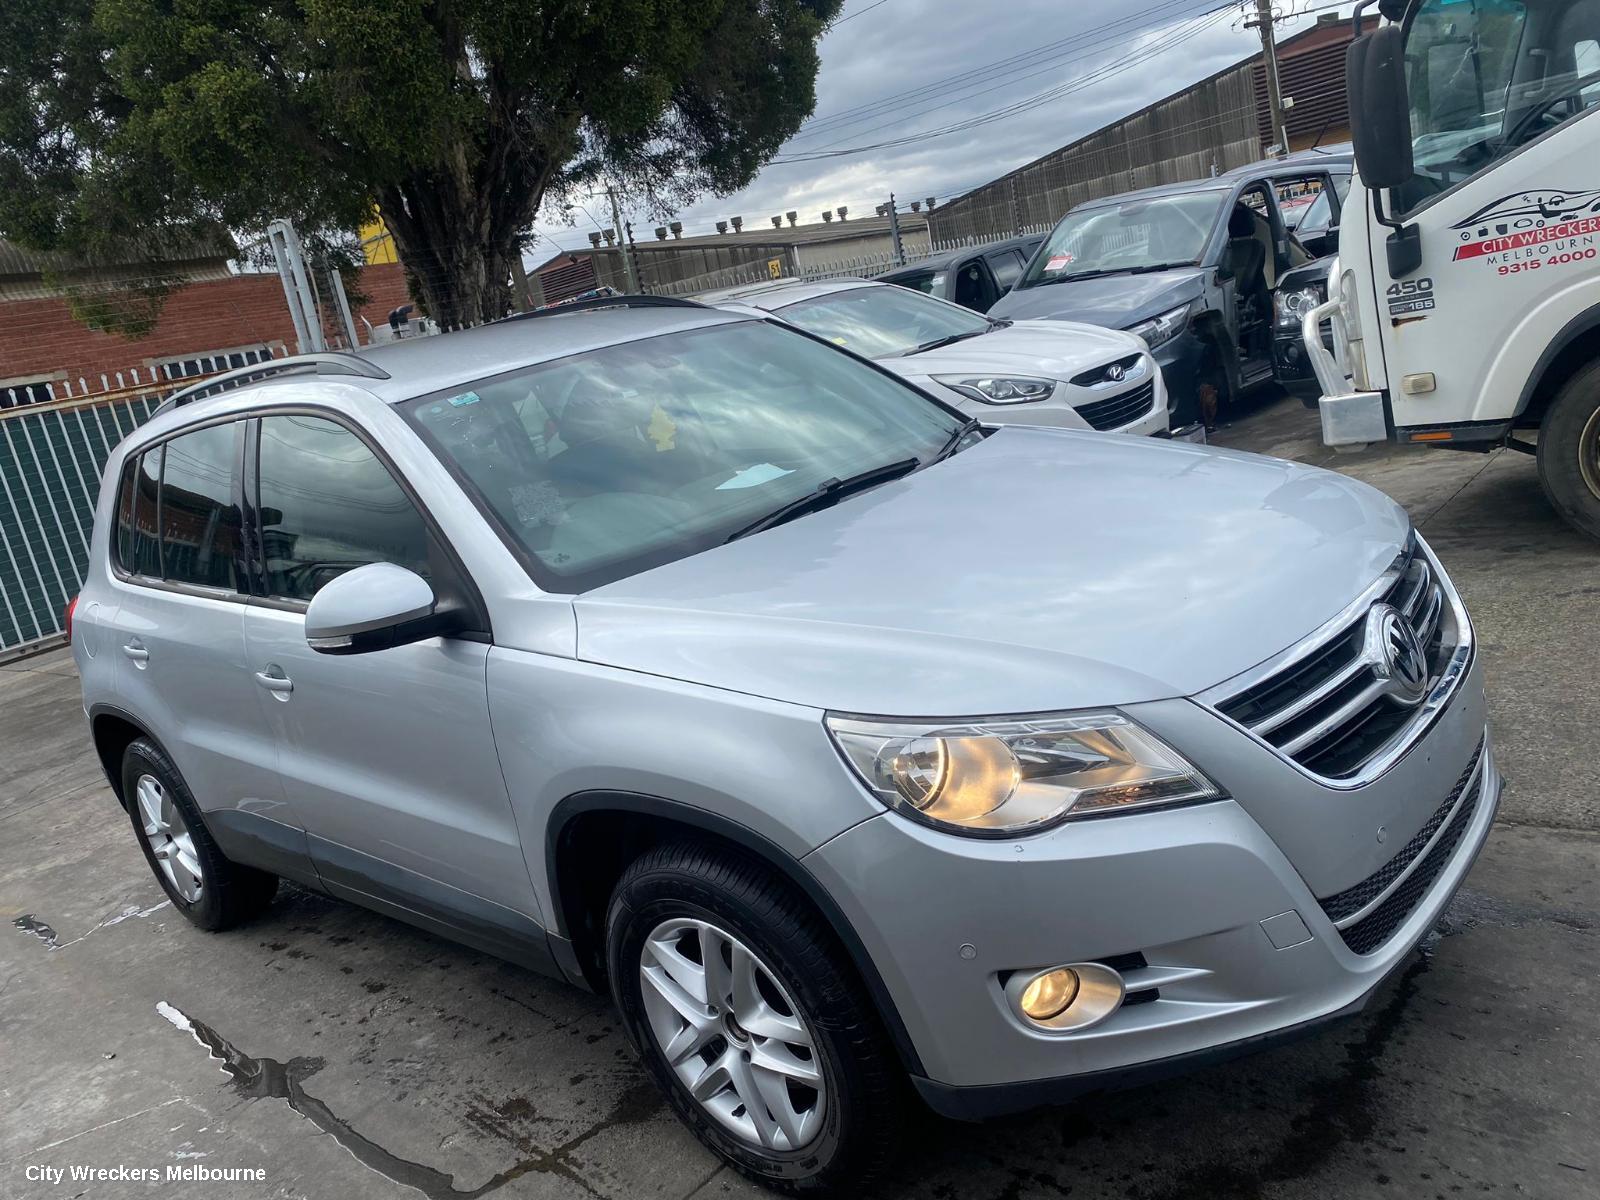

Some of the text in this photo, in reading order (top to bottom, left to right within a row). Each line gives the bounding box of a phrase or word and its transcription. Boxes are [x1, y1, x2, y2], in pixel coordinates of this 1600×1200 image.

[1481, 217, 1600, 253] CITY WRECKER
[770, 264, 780, 274] 51
[1498, 248, 1597, 275] 9315 4000
[1386, 277, 1433, 296] 450
[1408, 299, 1433, 310] 185
